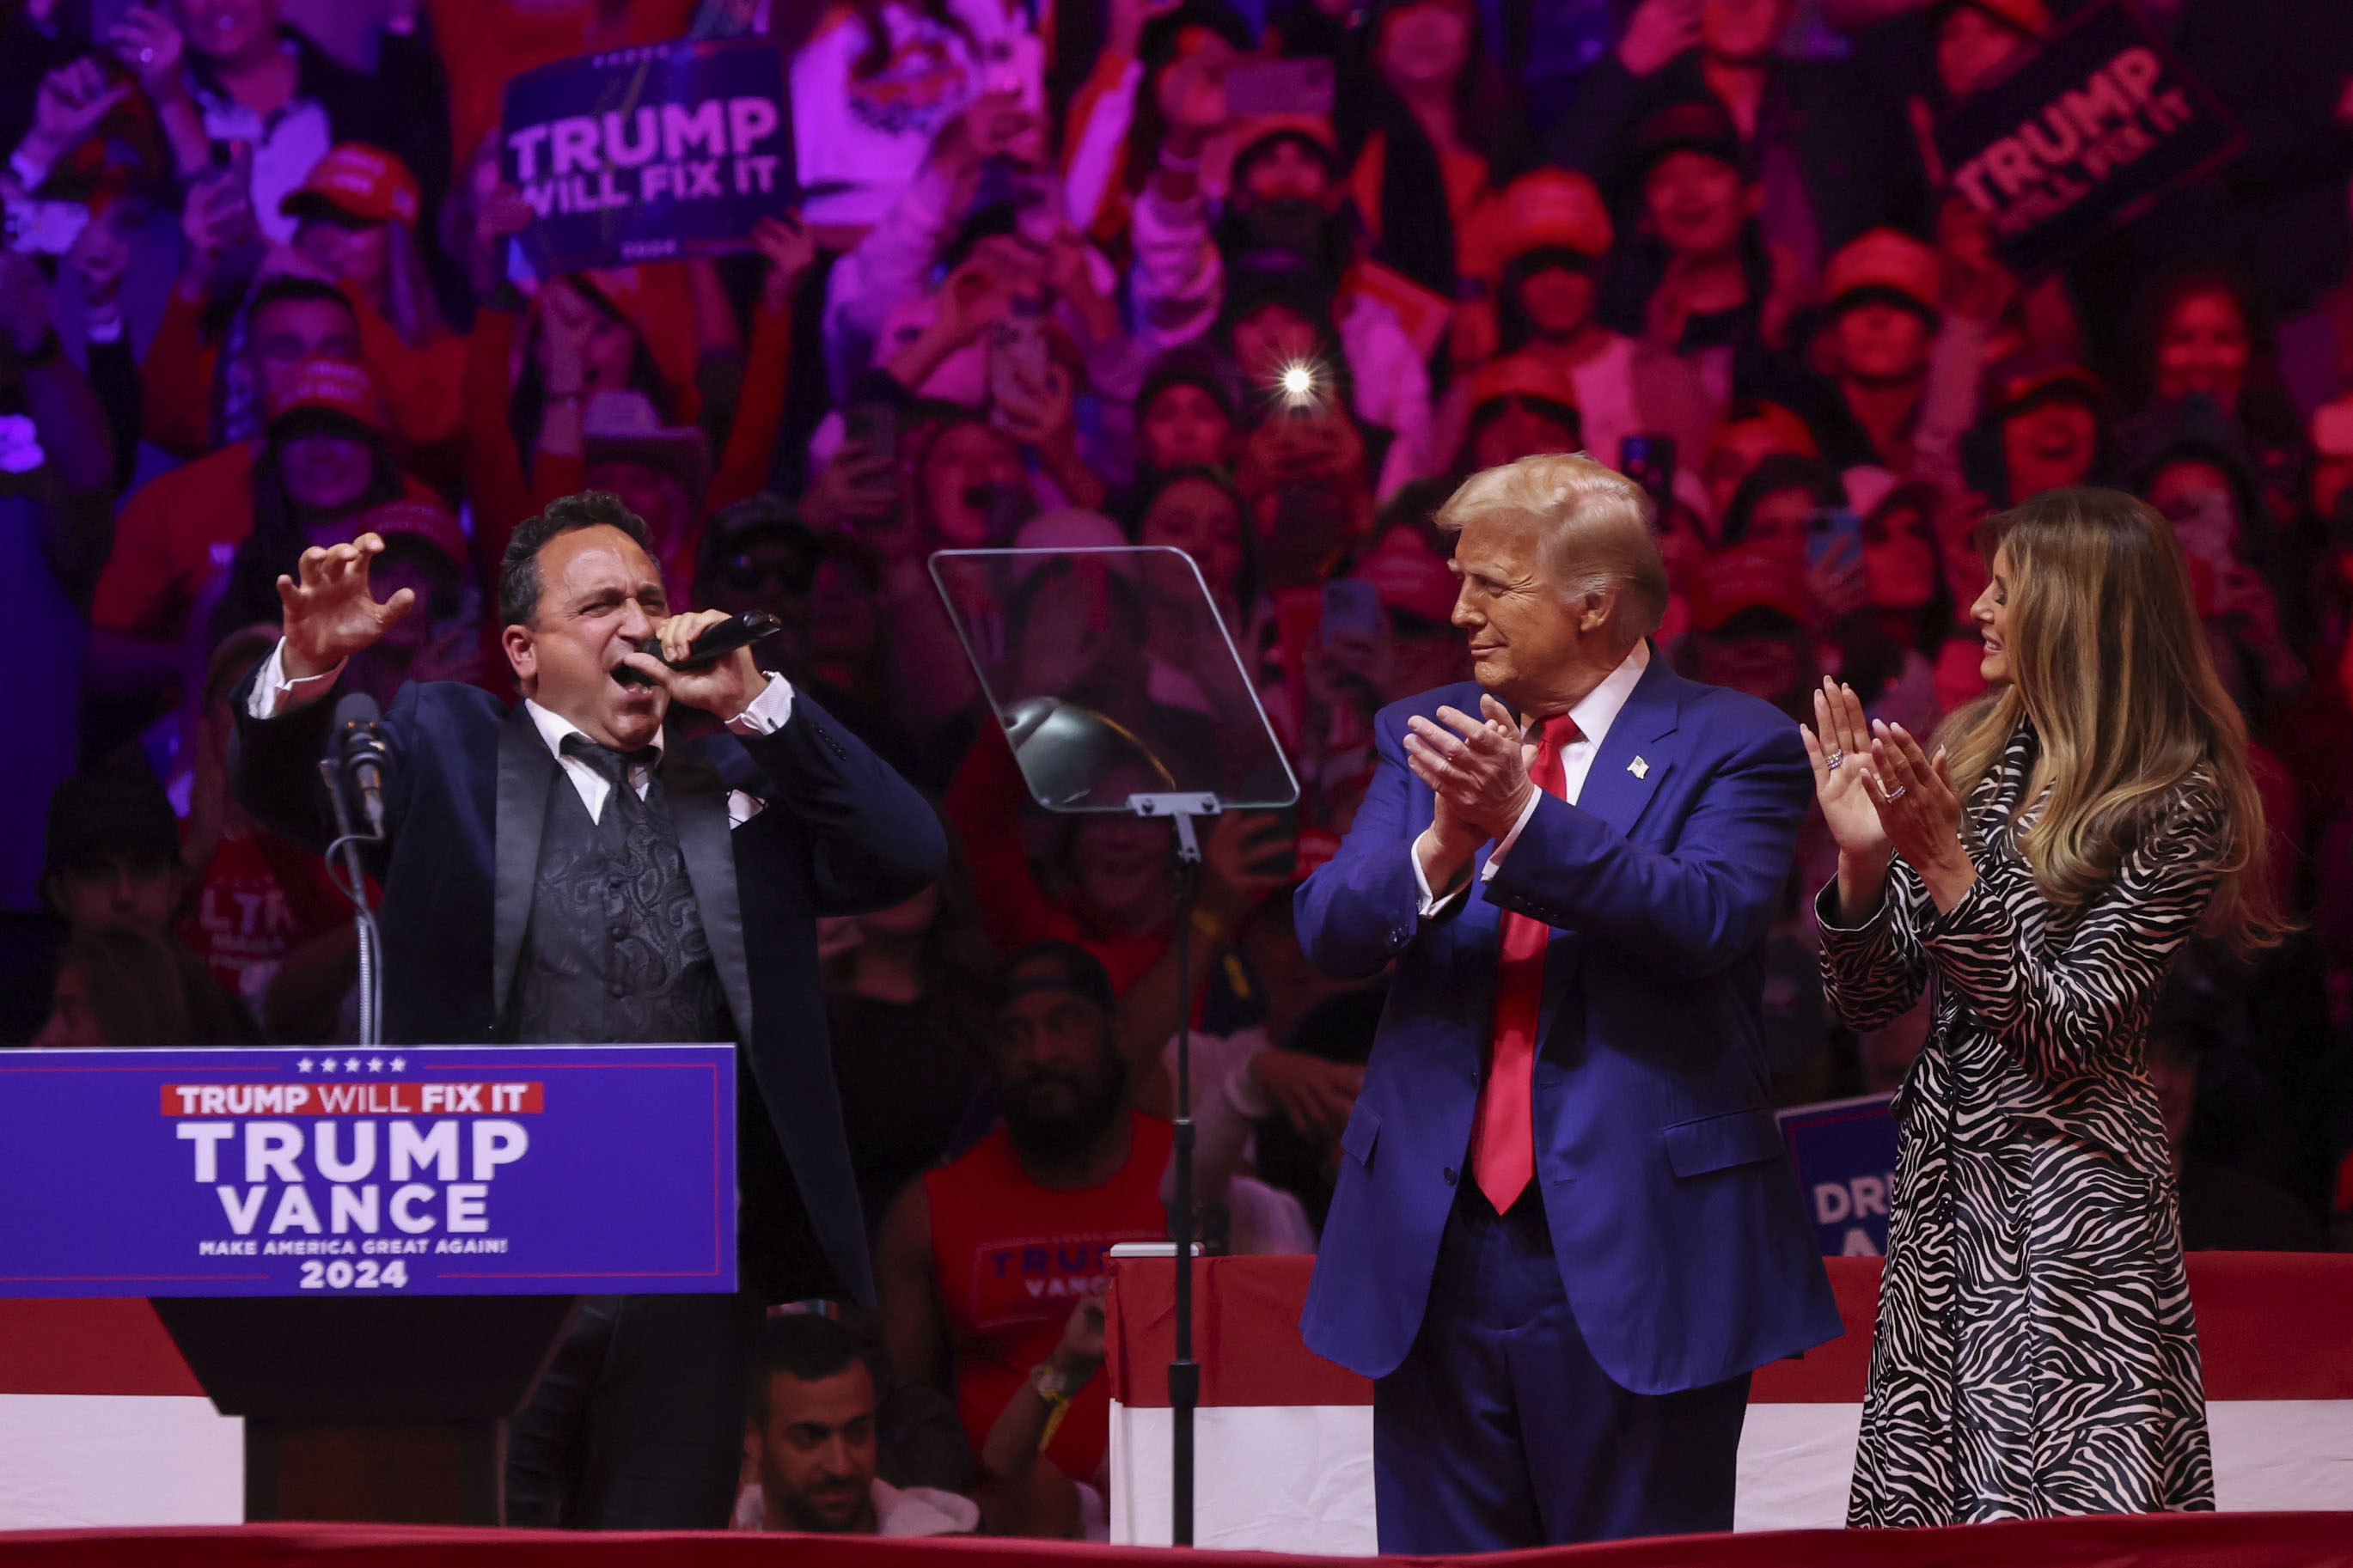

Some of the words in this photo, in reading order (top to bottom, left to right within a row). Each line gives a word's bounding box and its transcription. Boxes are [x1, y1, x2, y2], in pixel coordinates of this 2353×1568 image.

[508, 95, 777, 182] TRUMP
[1953, 46, 2161, 213] TRUMP
[640, 159, 723, 204] FIX
[734, 155, 779, 196] IT
[175, 1085, 309, 1114] TRUMP
[317, 1084, 412, 1113] WILL
[421, 1083, 483, 1113] FIX
[491, 1083, 528, 1112] IT
[175, 1119, 530, 1183] TRUMP
[216, 1182, 490, 1235] VANCE
[199, 1240, 258, 1256] MAKE
[262, 1239, 358, 1255] AMERICA
[361, 1238, 430, 1254] GREAT
[434, 1237, 509, 1254] AGAIN!
[299, 1259, 409, 1290] 2024
